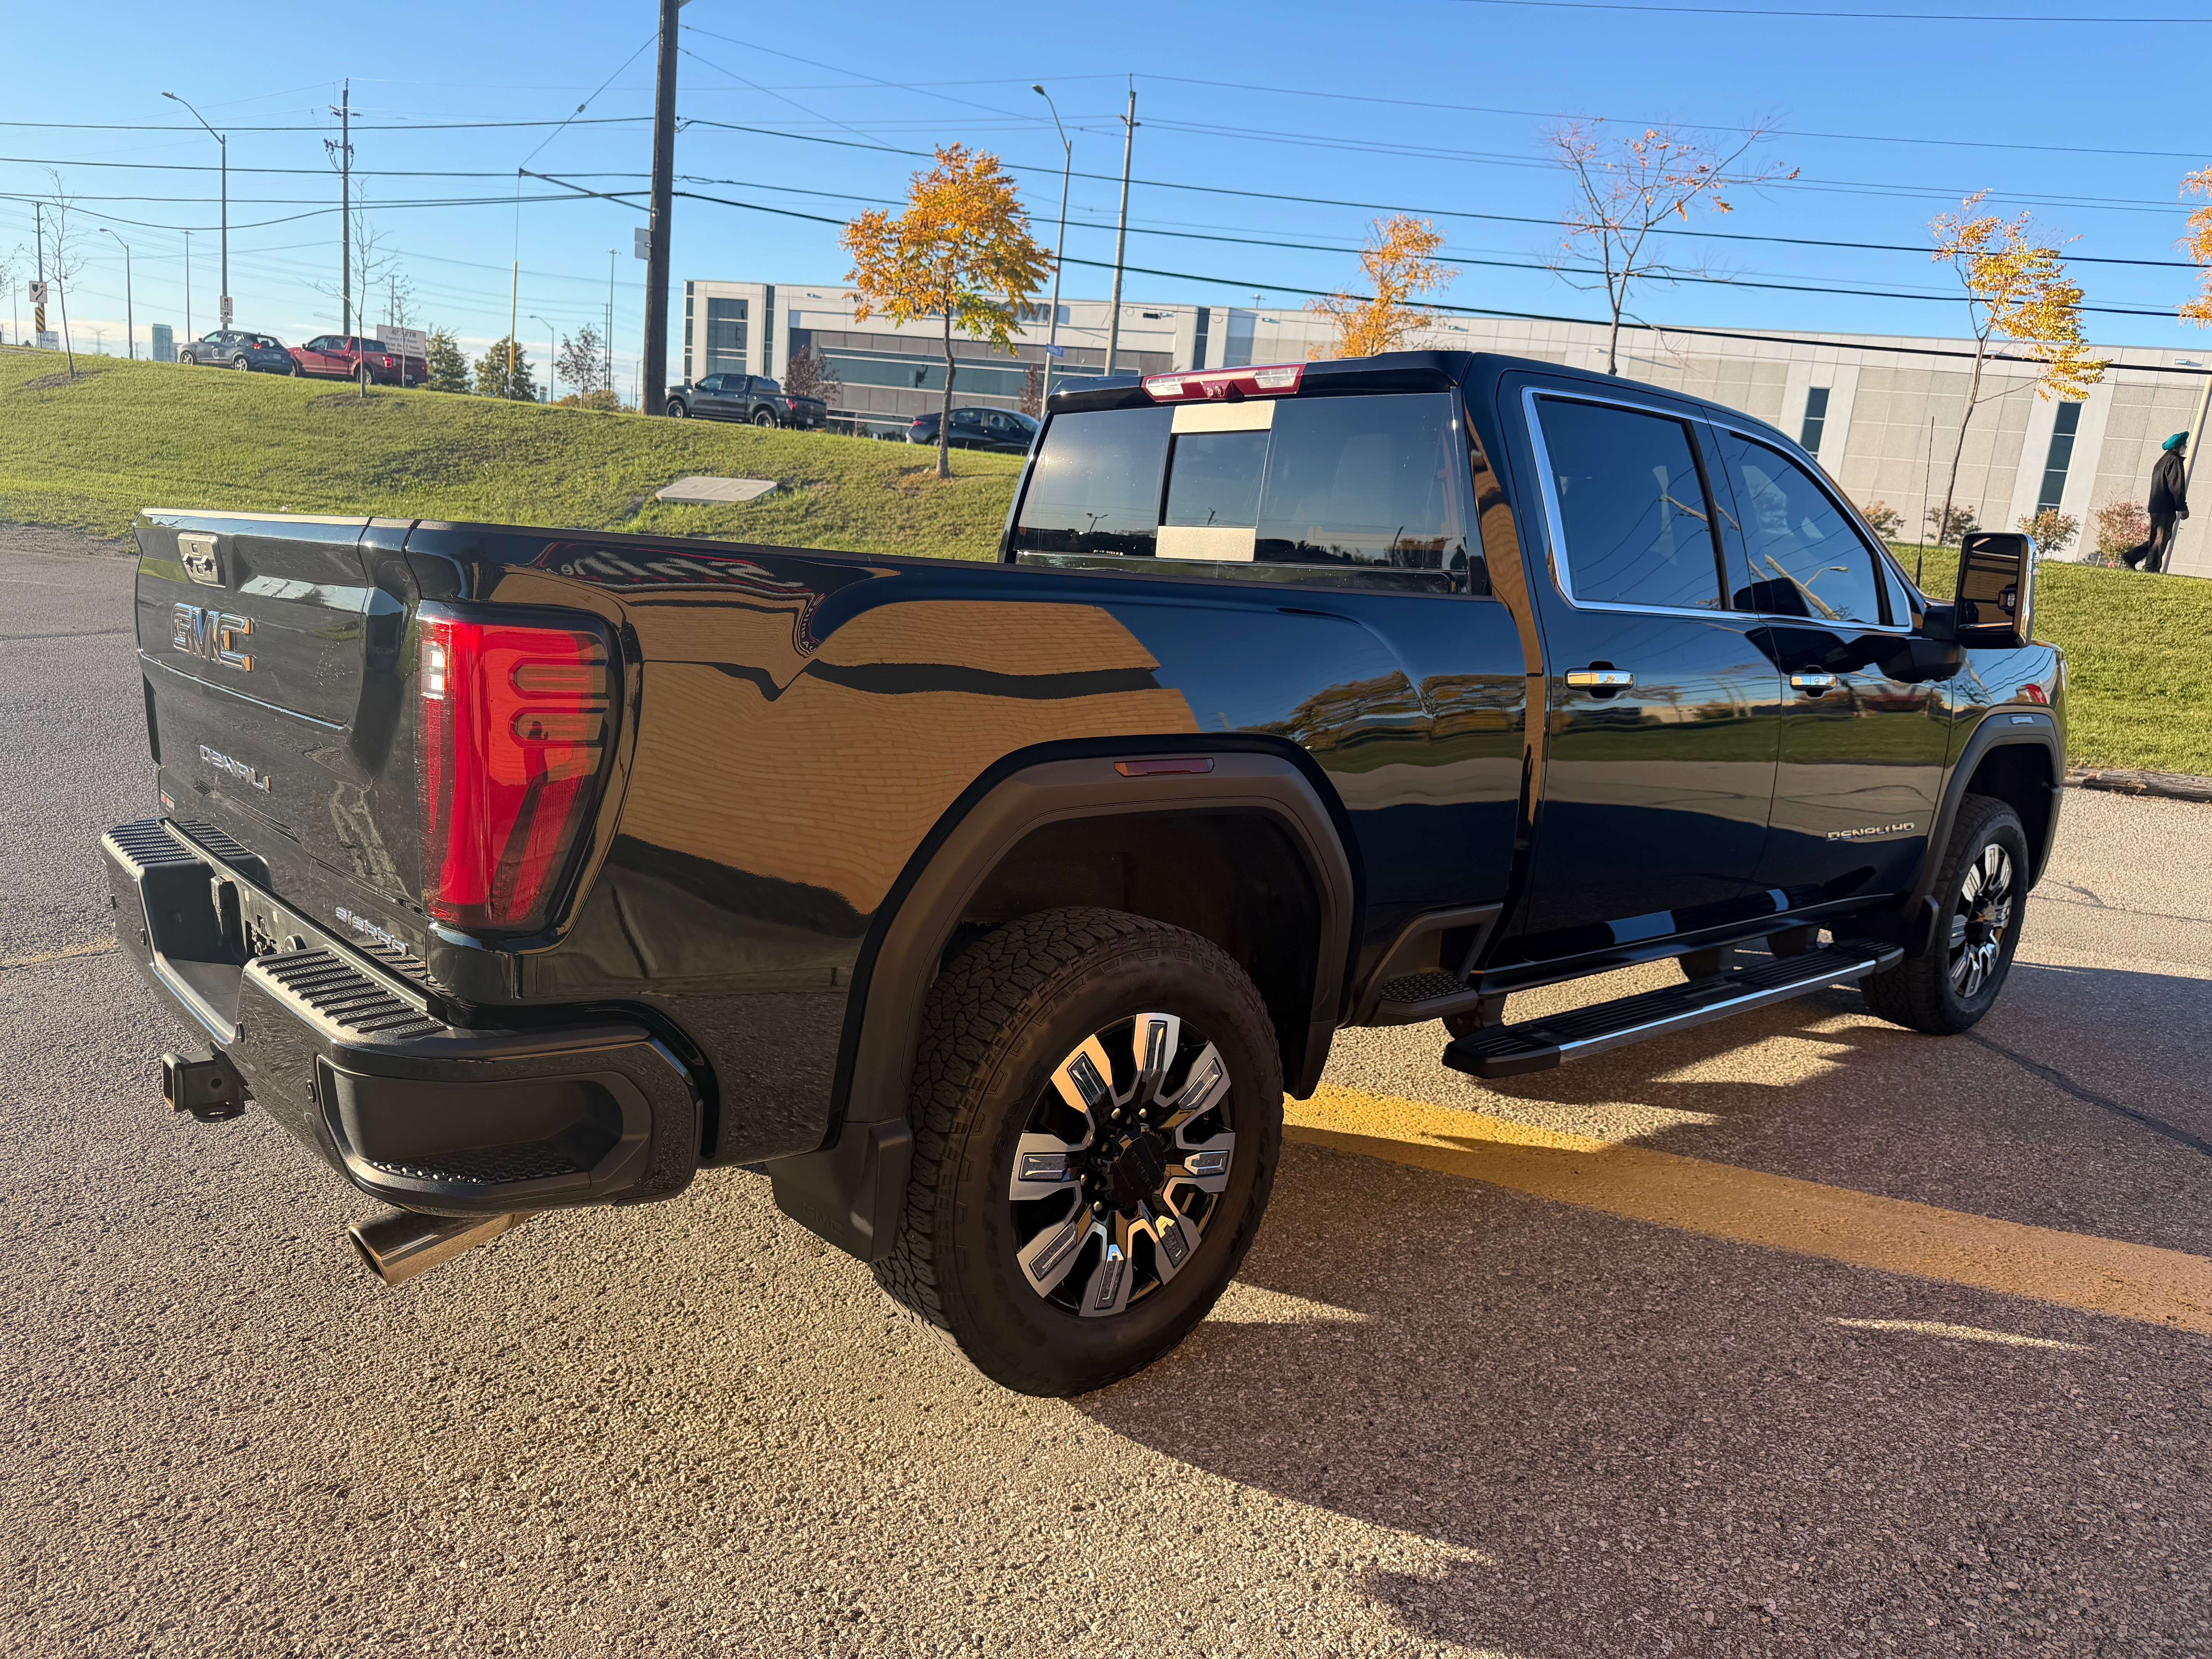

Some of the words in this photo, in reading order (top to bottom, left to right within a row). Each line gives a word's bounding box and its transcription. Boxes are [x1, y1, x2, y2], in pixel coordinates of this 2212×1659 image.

[171, 603, 255, 672] GMC
[199, 744, 272, 793] DENALI
[1827, 825, 1890, 841] DENALI
[1892, 822, 1915, 831] HD
[803, 1202, 845, 1237] GMC
